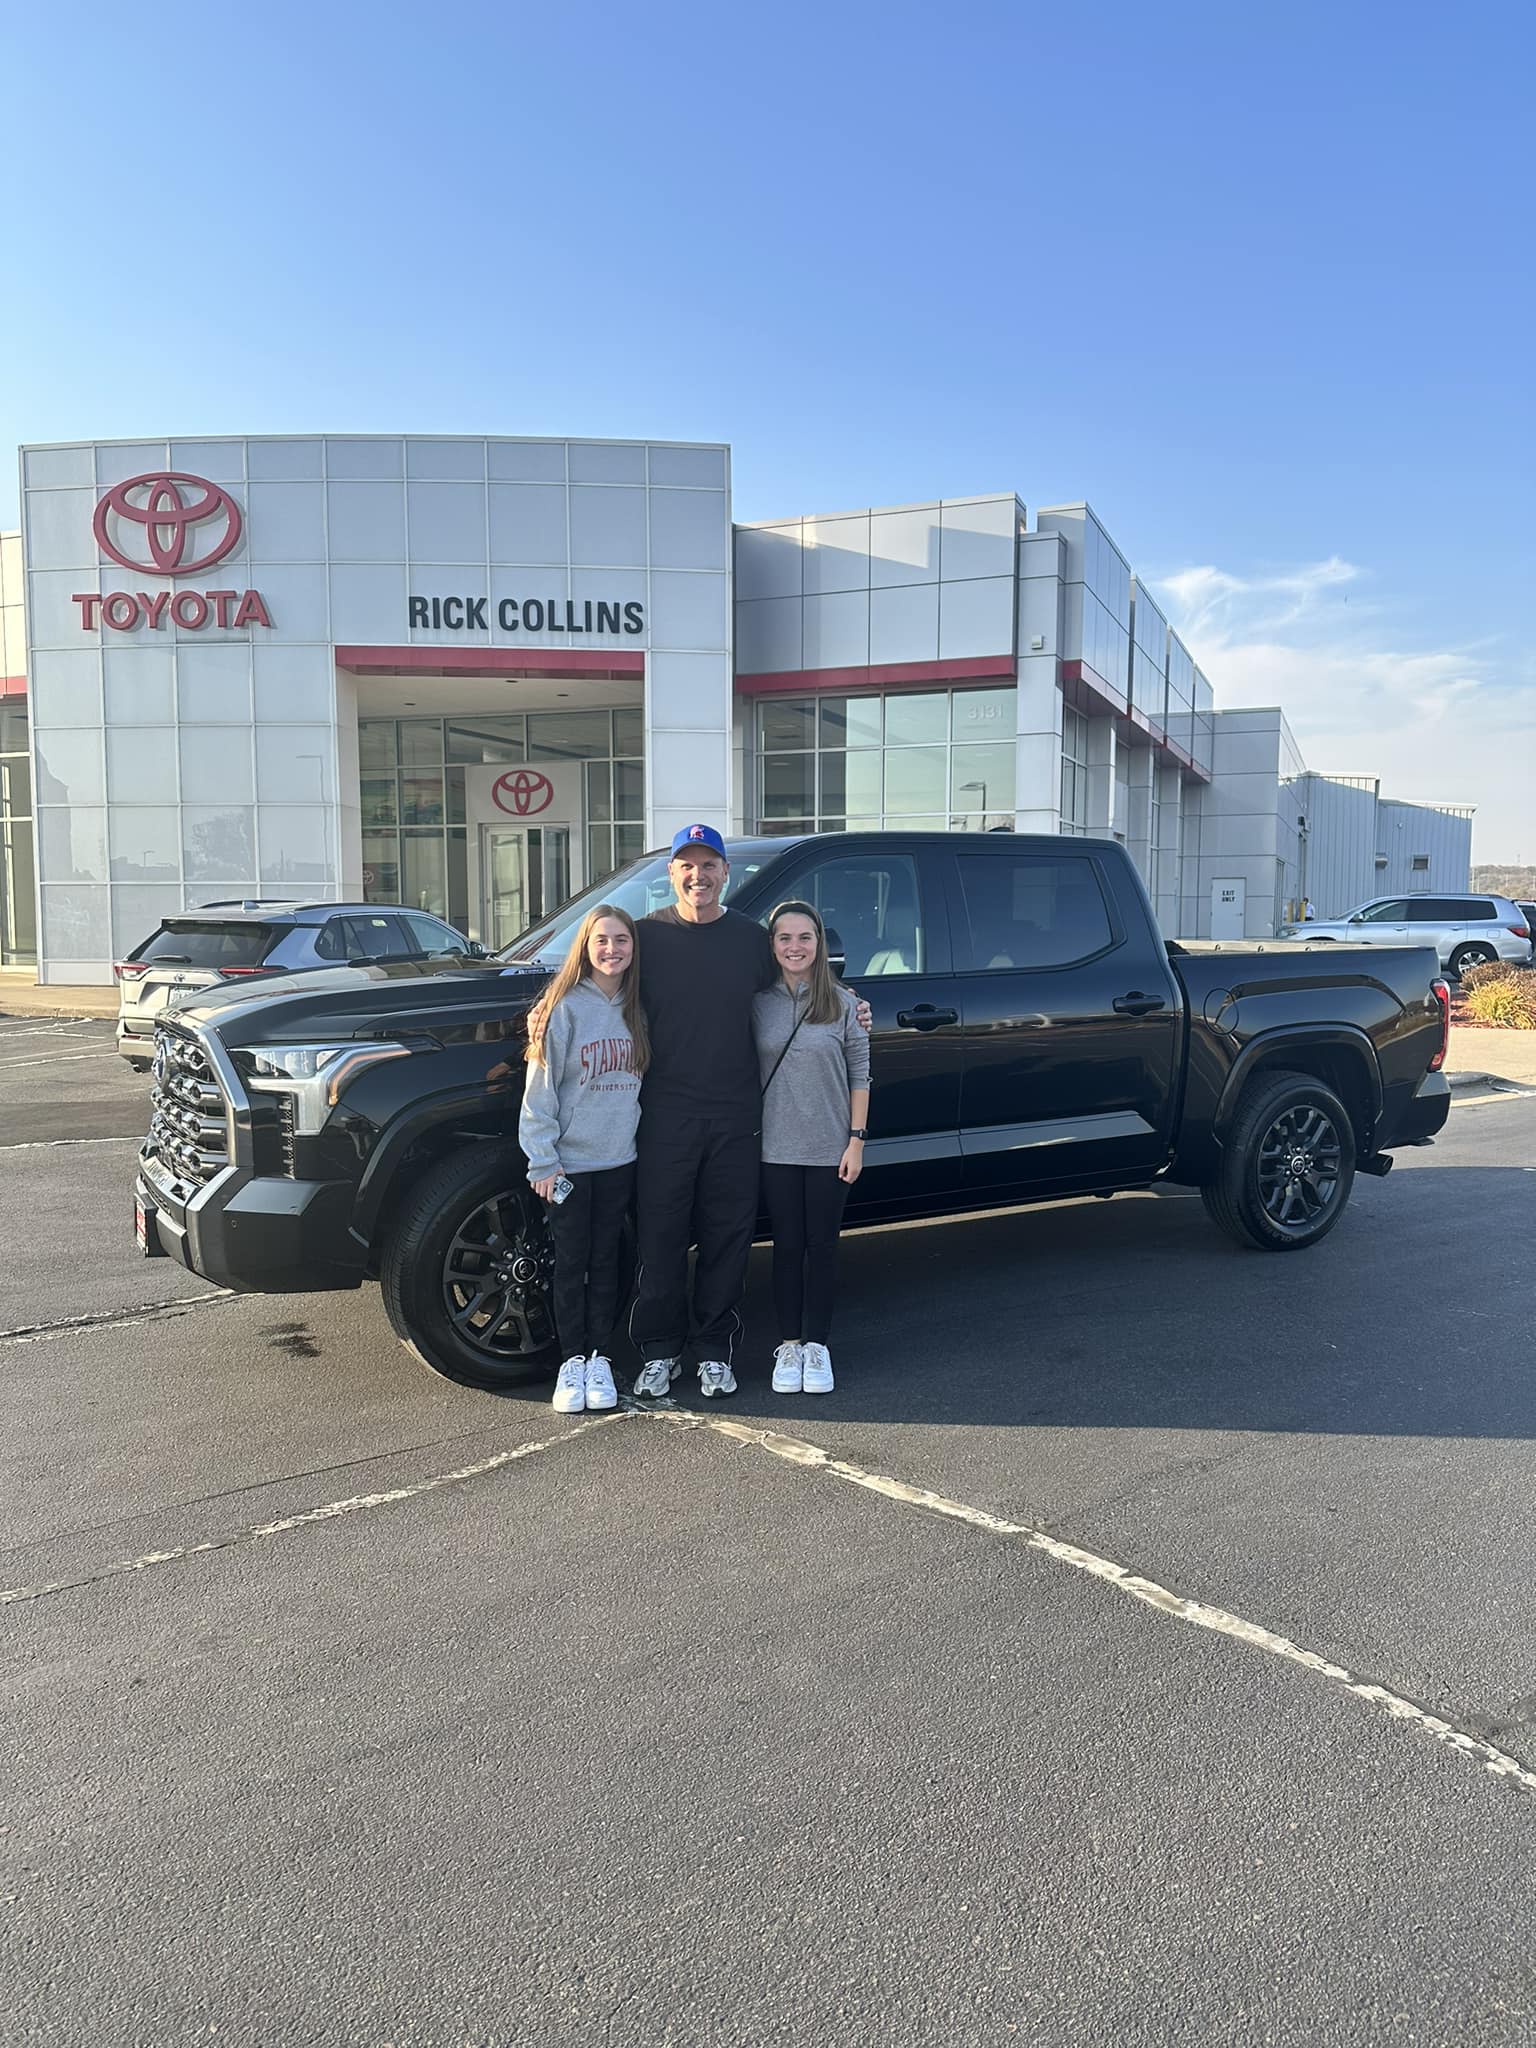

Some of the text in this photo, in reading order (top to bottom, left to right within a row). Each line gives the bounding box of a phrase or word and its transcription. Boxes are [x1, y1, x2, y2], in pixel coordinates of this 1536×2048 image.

[71, 589, 272, 631] TOYOTA
[408, 596, 644, 635] RICK COLLINS
[589, 1083, 638, 1092] UNIVERSITY
